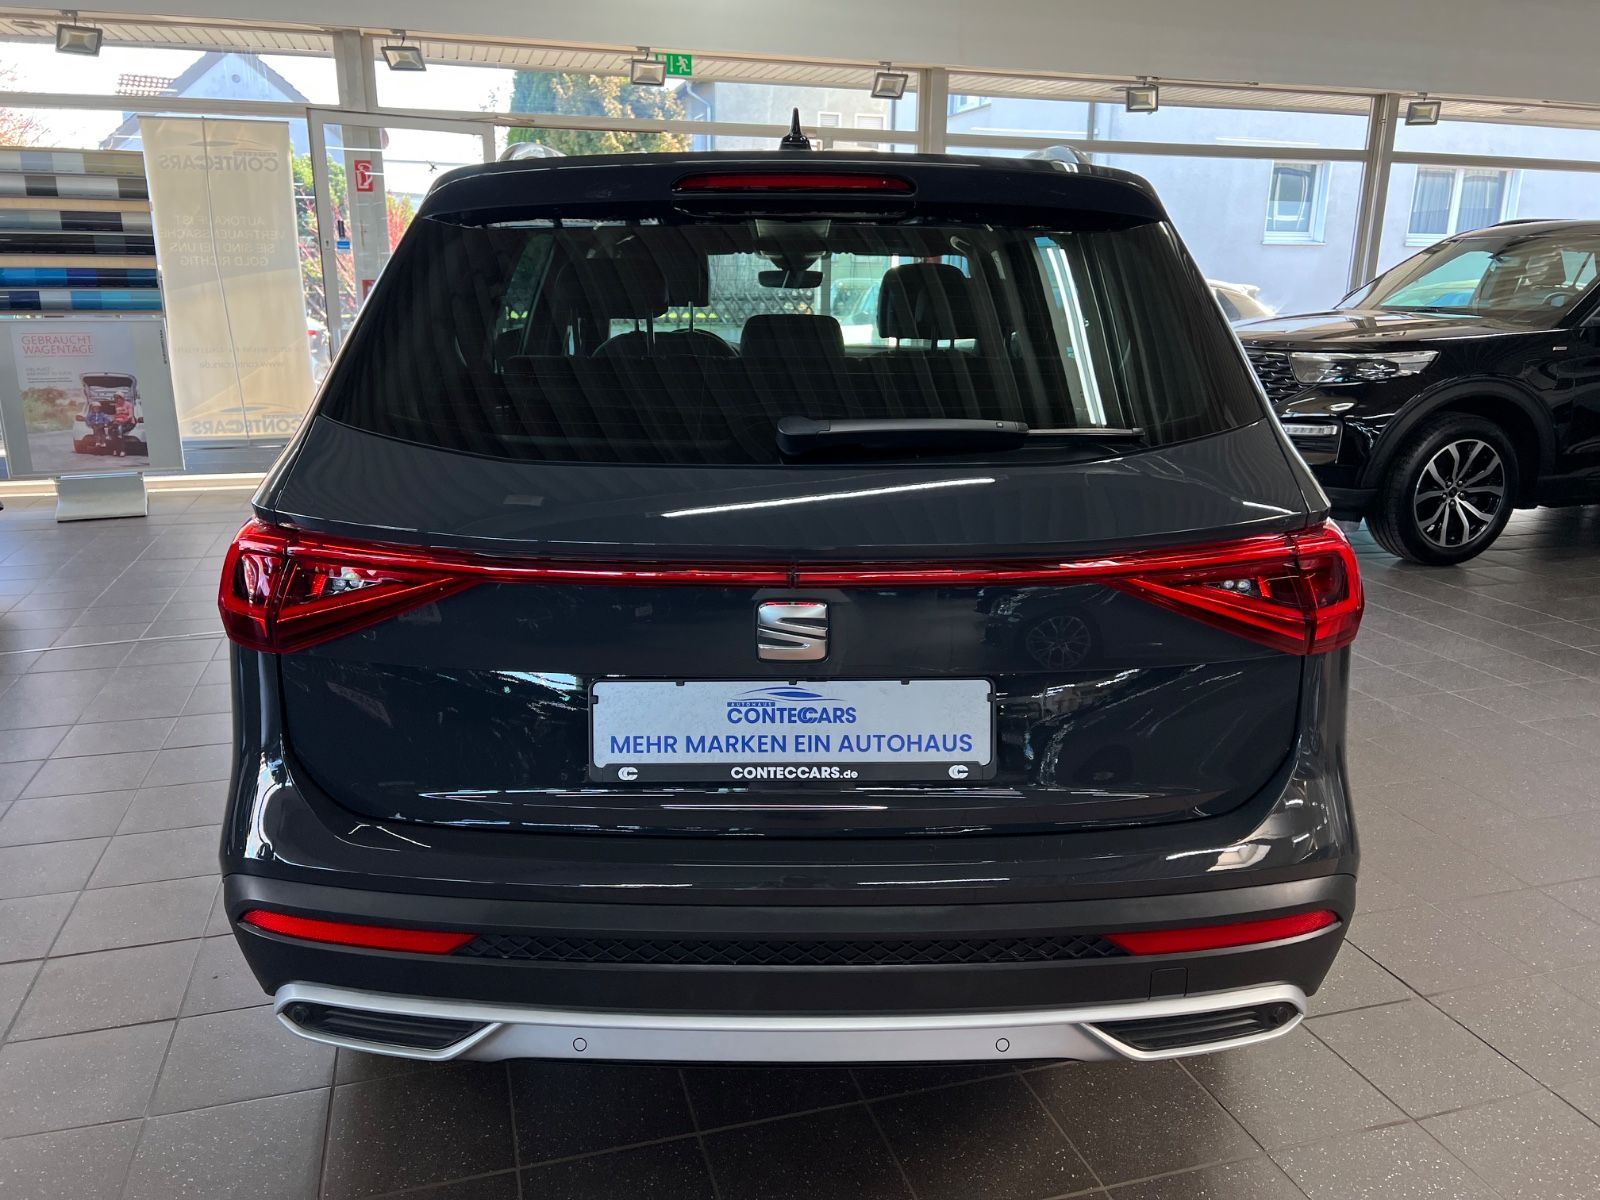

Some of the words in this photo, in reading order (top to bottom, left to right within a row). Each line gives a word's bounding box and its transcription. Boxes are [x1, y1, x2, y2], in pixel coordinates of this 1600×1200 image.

[21, 335, 91, 345] GEBRAUCHT
[22, 345, 94, 354] WAGENTAGE
[610, 735, 678, 753] MEHR
[685, 735, 787, 753] MARKEN
[794, 735, 830, 753] EIN
[838, 734, 972, 752] AUTOHAUS
[731, 766, 858, 779] CONTECCARS.de
